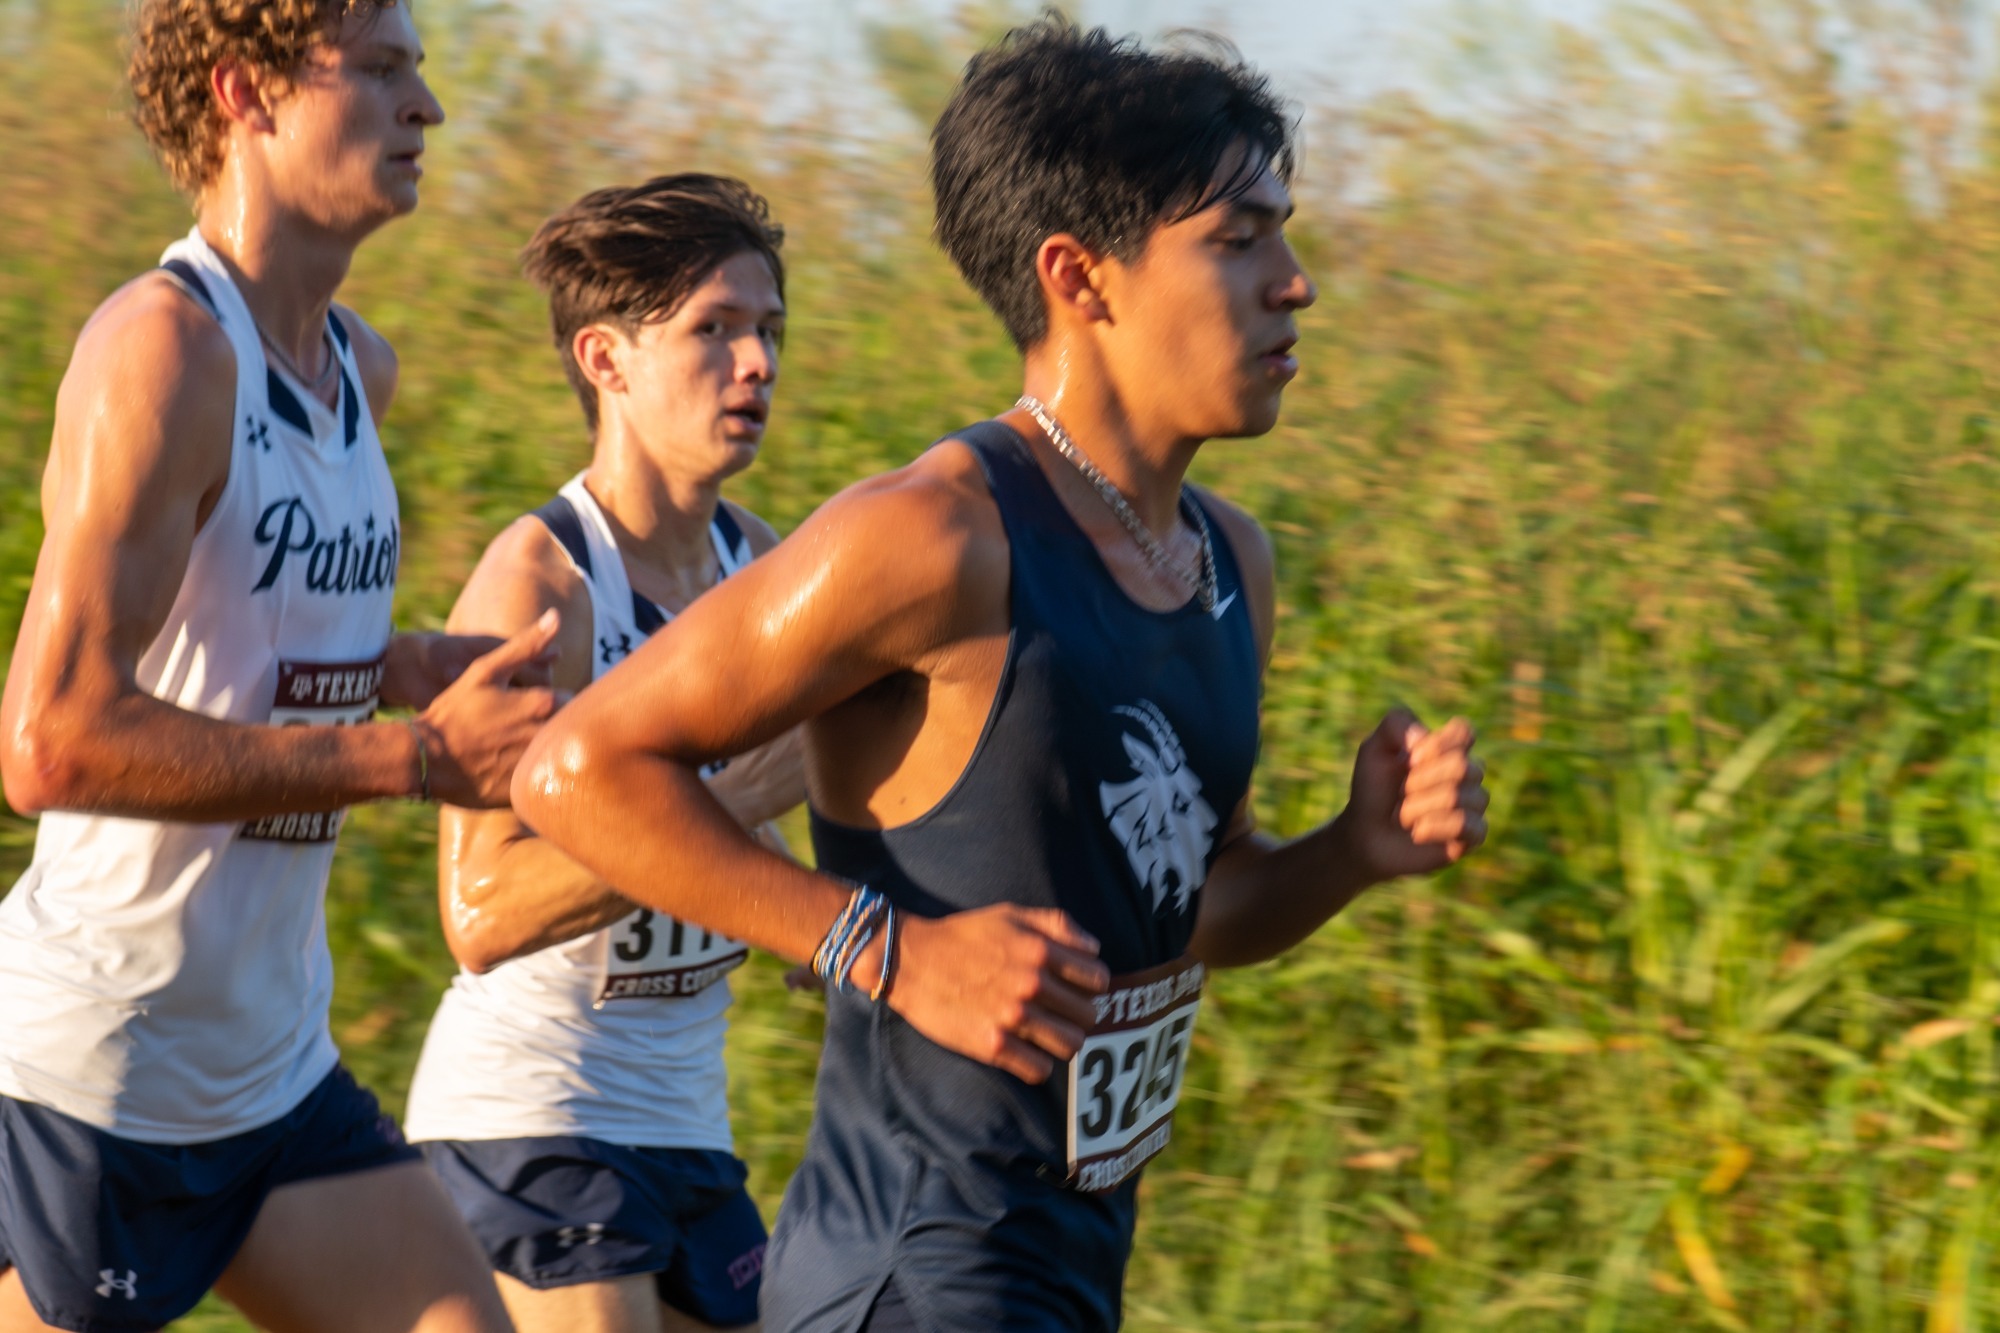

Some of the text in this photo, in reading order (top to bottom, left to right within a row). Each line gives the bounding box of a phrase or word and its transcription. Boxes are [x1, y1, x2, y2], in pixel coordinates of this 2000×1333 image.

[315, 668, 374, 703] TEXAS
[255, 811, 323, 839] CROSS
[611, 974, 676, 996] CROSS
